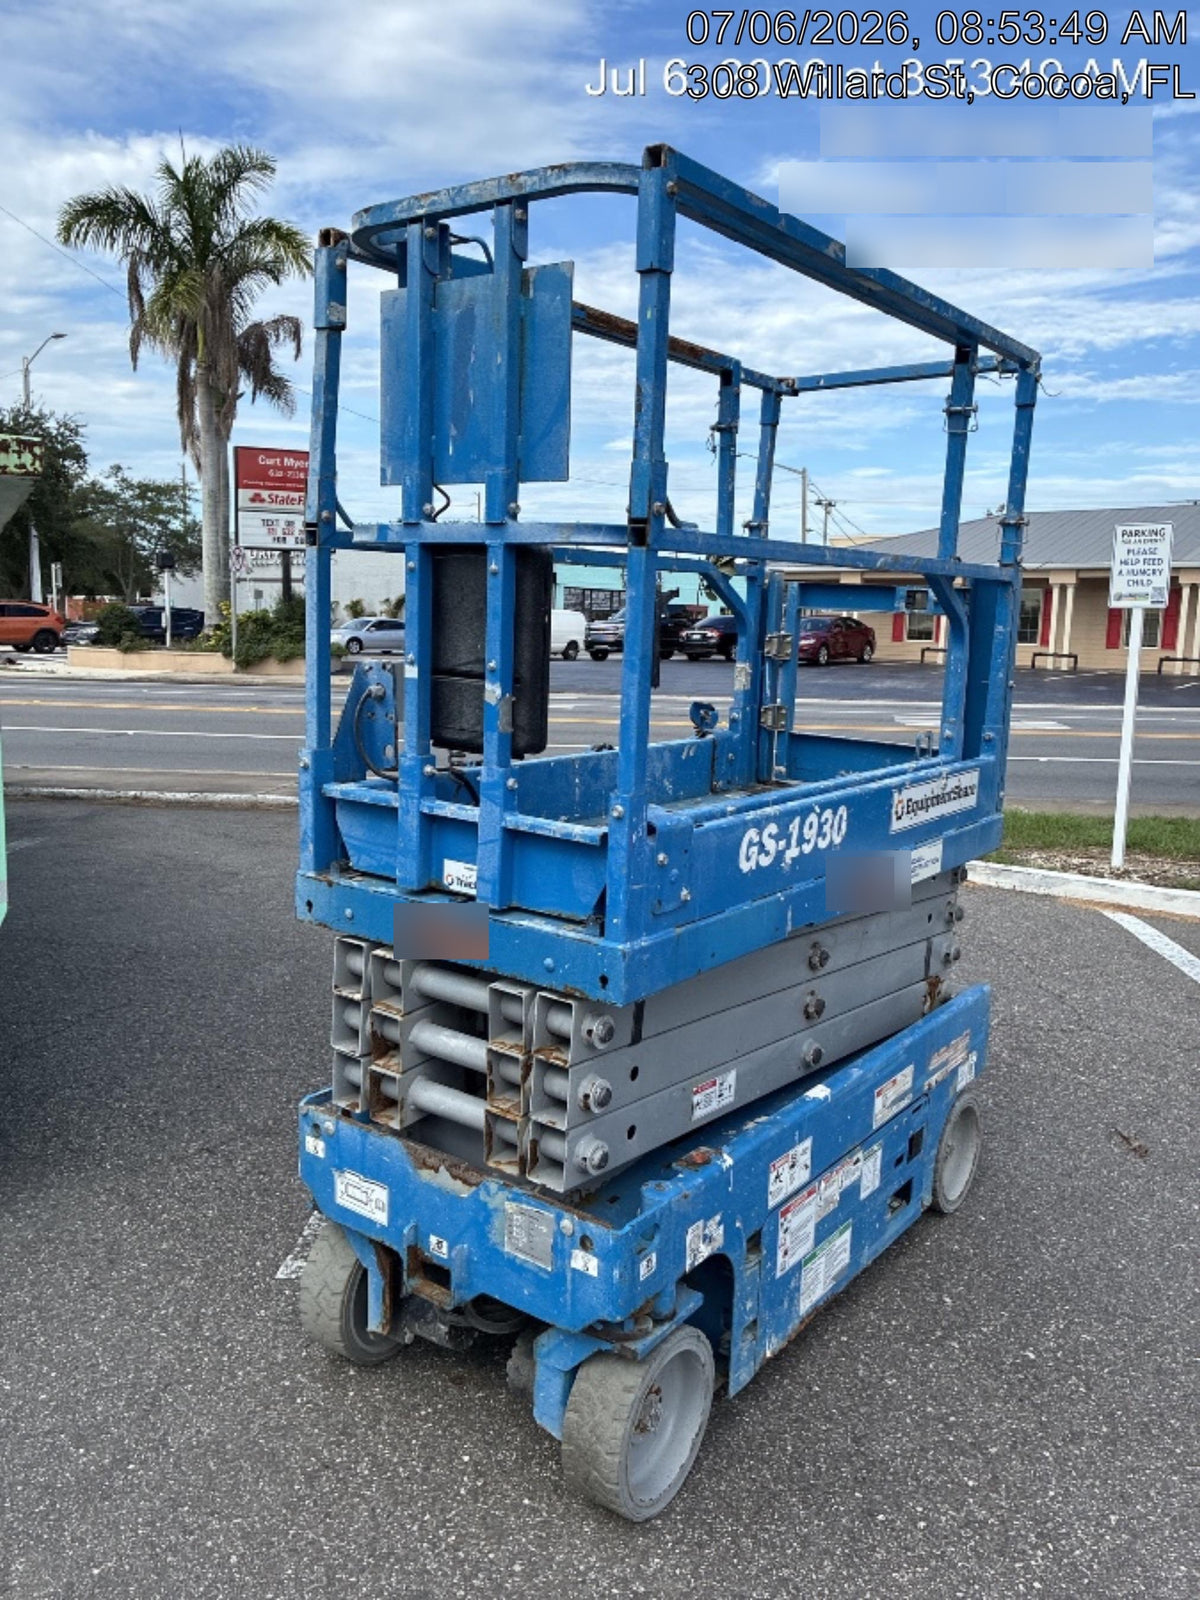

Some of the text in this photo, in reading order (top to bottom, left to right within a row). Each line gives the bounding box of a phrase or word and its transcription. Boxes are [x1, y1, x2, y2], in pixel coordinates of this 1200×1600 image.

[258, 455, 281, 466] Curt
[1121, 527, 1166, 538] PARKING
[1127, 547, 1158, 556] PLEASE
[1119, 558, 1164, 566] HELP FEED
[1126, 568, 1164, 577] HUNGRY
[1127, 579, 1153, 587] CHILD
[739, 805, 848, 873] GS-1930
